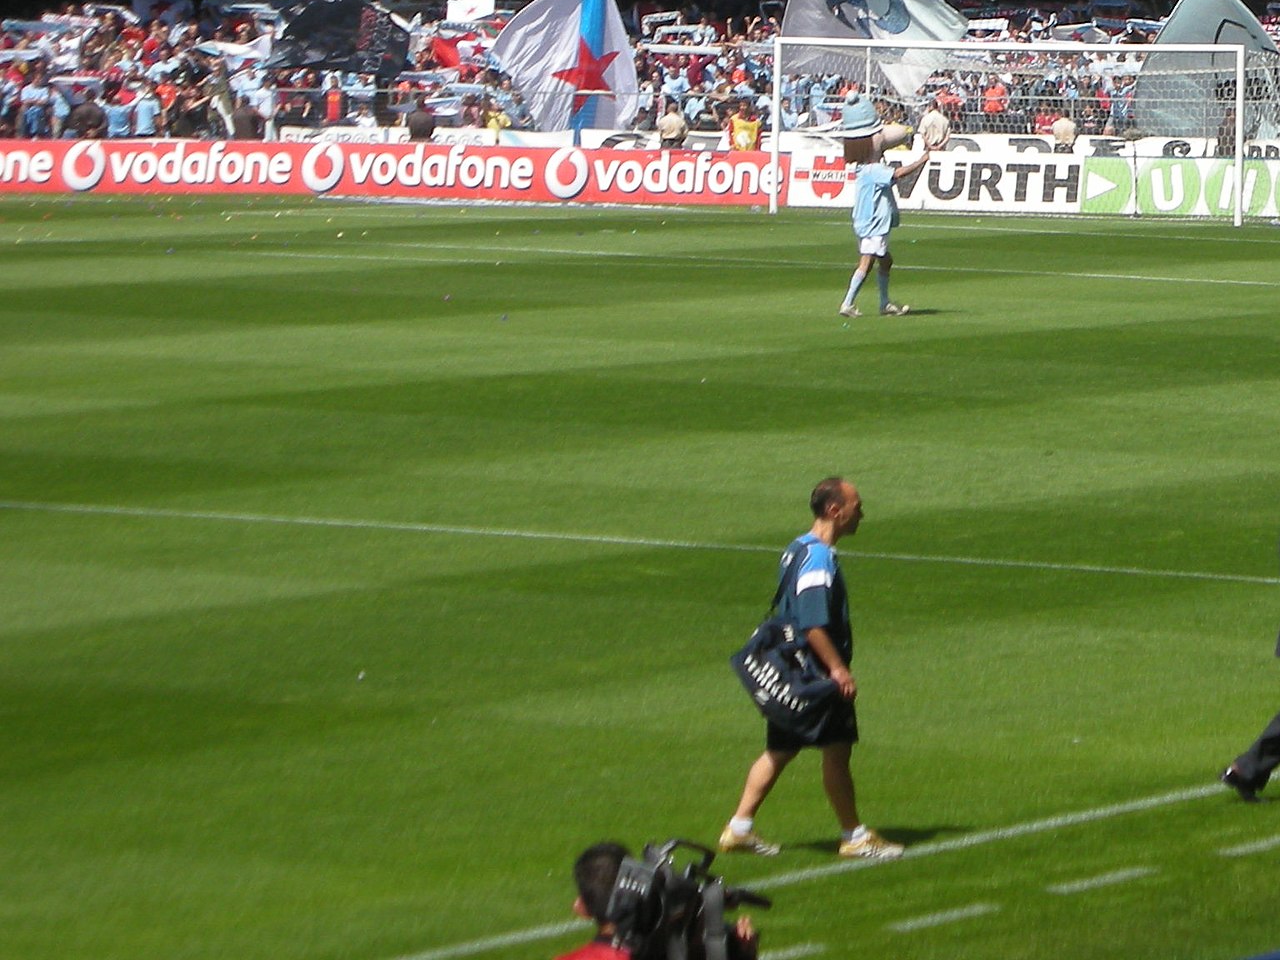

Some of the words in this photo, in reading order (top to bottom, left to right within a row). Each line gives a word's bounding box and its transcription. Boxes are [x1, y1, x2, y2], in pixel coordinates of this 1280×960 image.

[110, 142, 292, 184] vodafone
[350, 145, 534, 190] vodafone
[593, 150, 784, 195] vodafone
[884, 160, 1078, 203] WÜRTH
